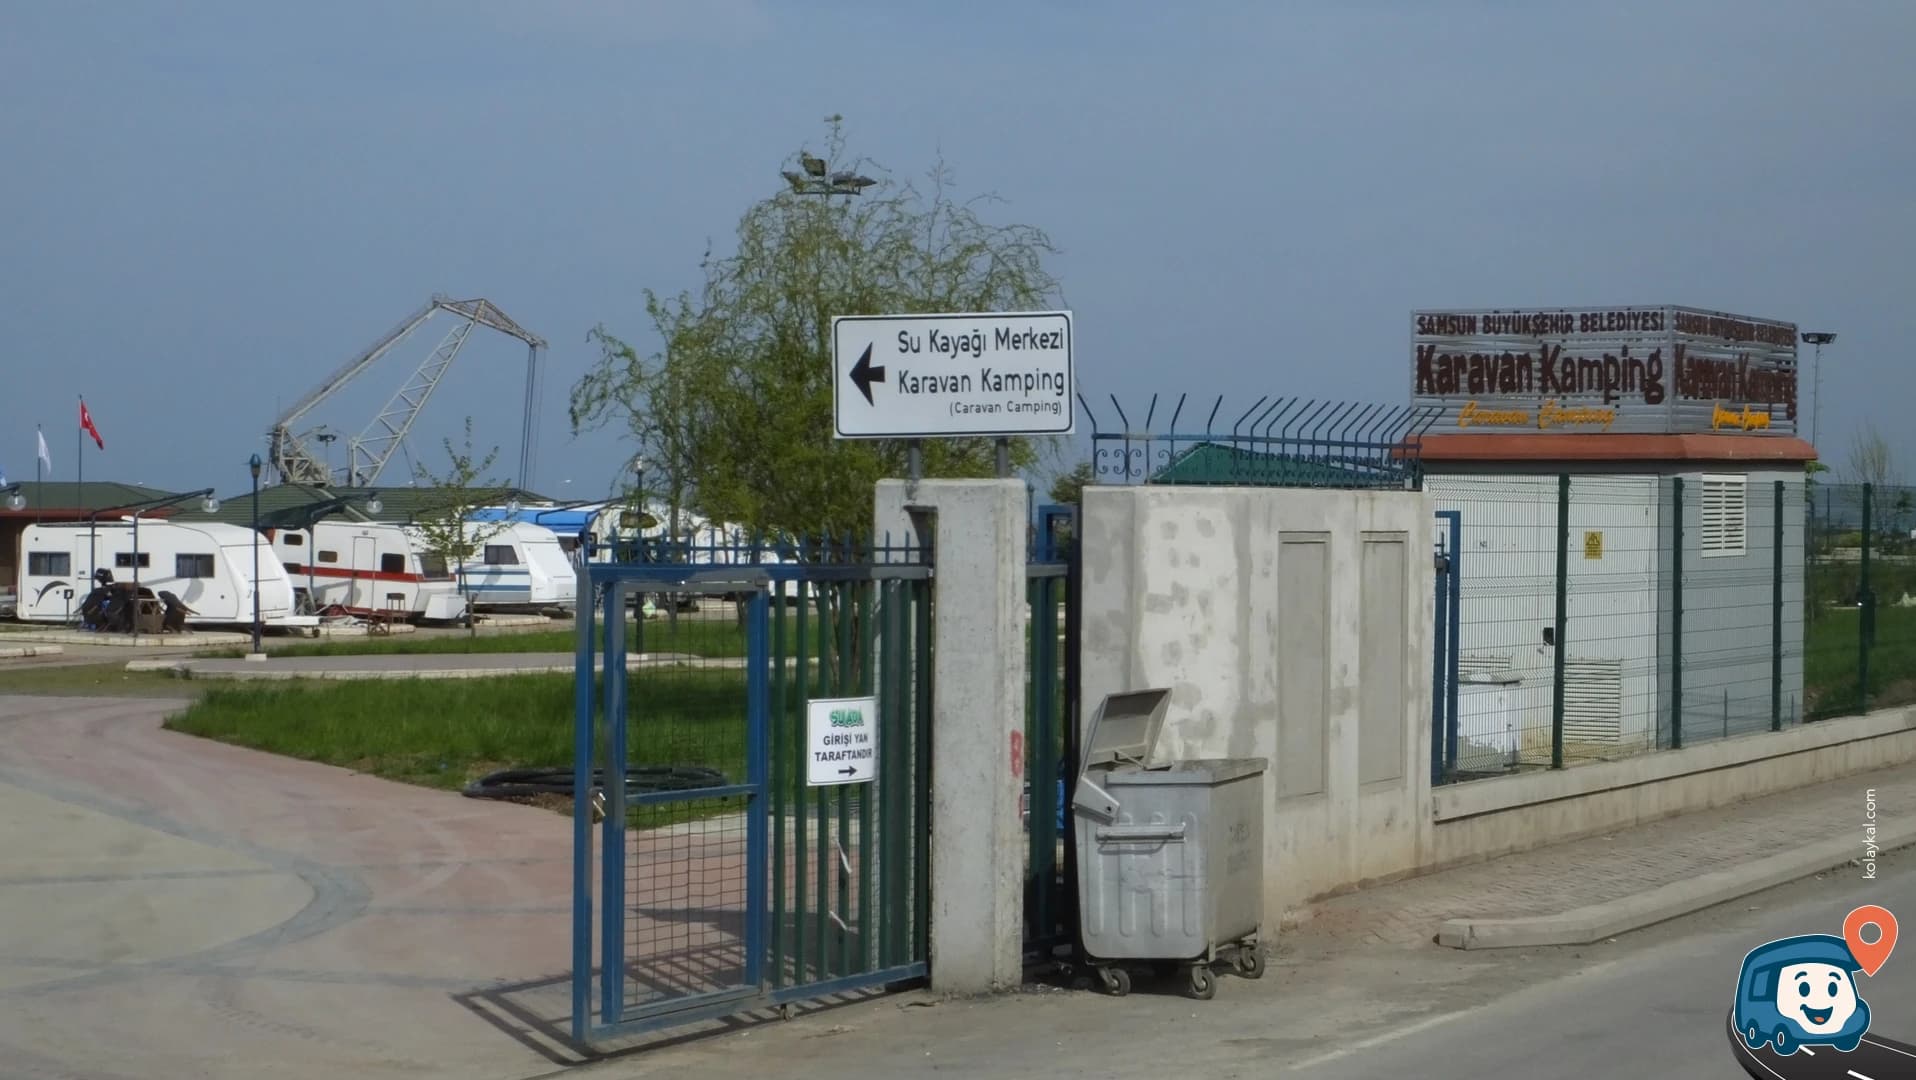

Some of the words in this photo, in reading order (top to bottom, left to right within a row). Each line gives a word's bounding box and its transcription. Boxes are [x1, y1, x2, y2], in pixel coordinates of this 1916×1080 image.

[1416, 314, 1477, 335] SAMSUN
[1482, 309, 1574, 338] BÜYÜKŞEHİR
[1579, 307, 1665, 332] BELEDİYESİ
[898, 330, 921, 353] Su
[929, 329, 987, 358] Kayağı
[995, 327, 1064, 351] Merkezi
[898, 370, 972, 394] Karavan
[981, 368, 1065, 397] Kamping
[1416, 344, 1534, 395] Karavan
[1540, 343, 1665, 405] Kamping
[949, 402, 1002, 416] (Caravan
[1006, 400, 1062, 415] Camping)
[823, 733, 852, 747] GİRİŞİ
[815, 748, 873, 762] TARAFTANDIR
